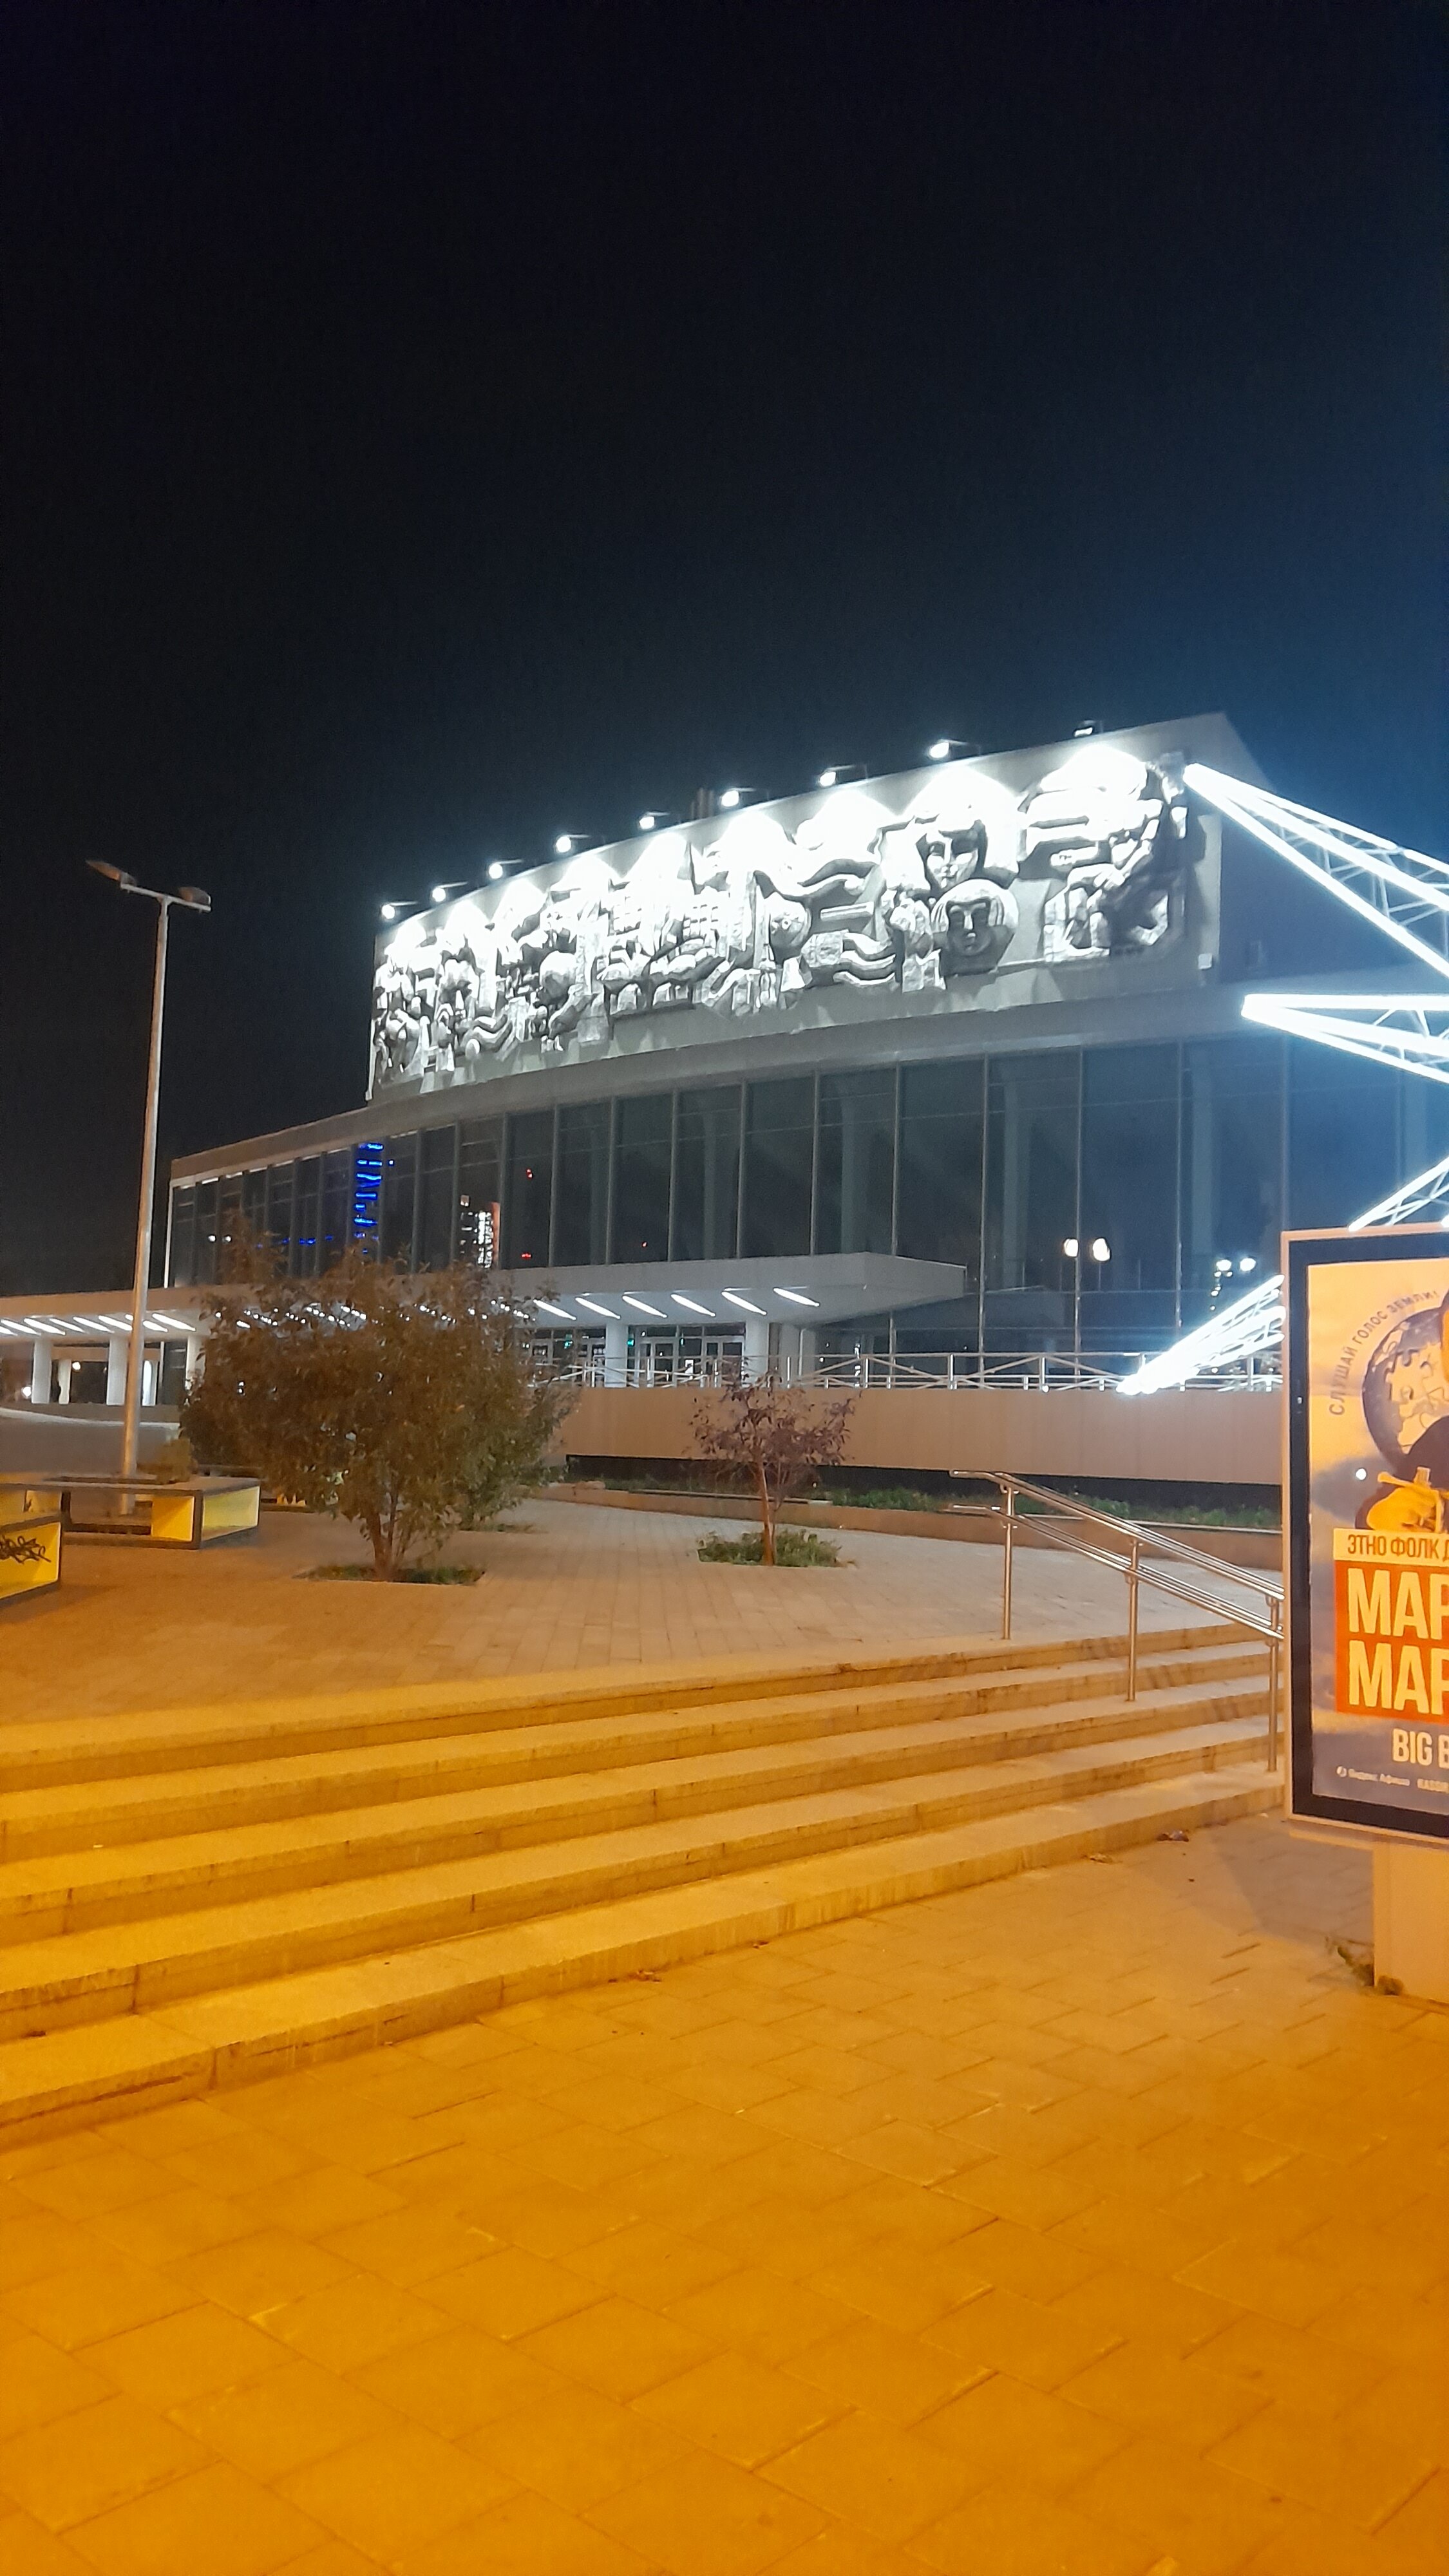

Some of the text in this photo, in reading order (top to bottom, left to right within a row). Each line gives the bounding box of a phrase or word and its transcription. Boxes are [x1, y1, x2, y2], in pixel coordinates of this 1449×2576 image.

[1329, 1291, 1440, 1416] СЛУШАЙ ГОЛОС ЗЕМЛИ!
[1347, 1534, 1387, 1556] ЭТНО
[1390, 1537, 1439, 1559] ФОЛК
[1392, 1728, 1433, 1766] BIG
